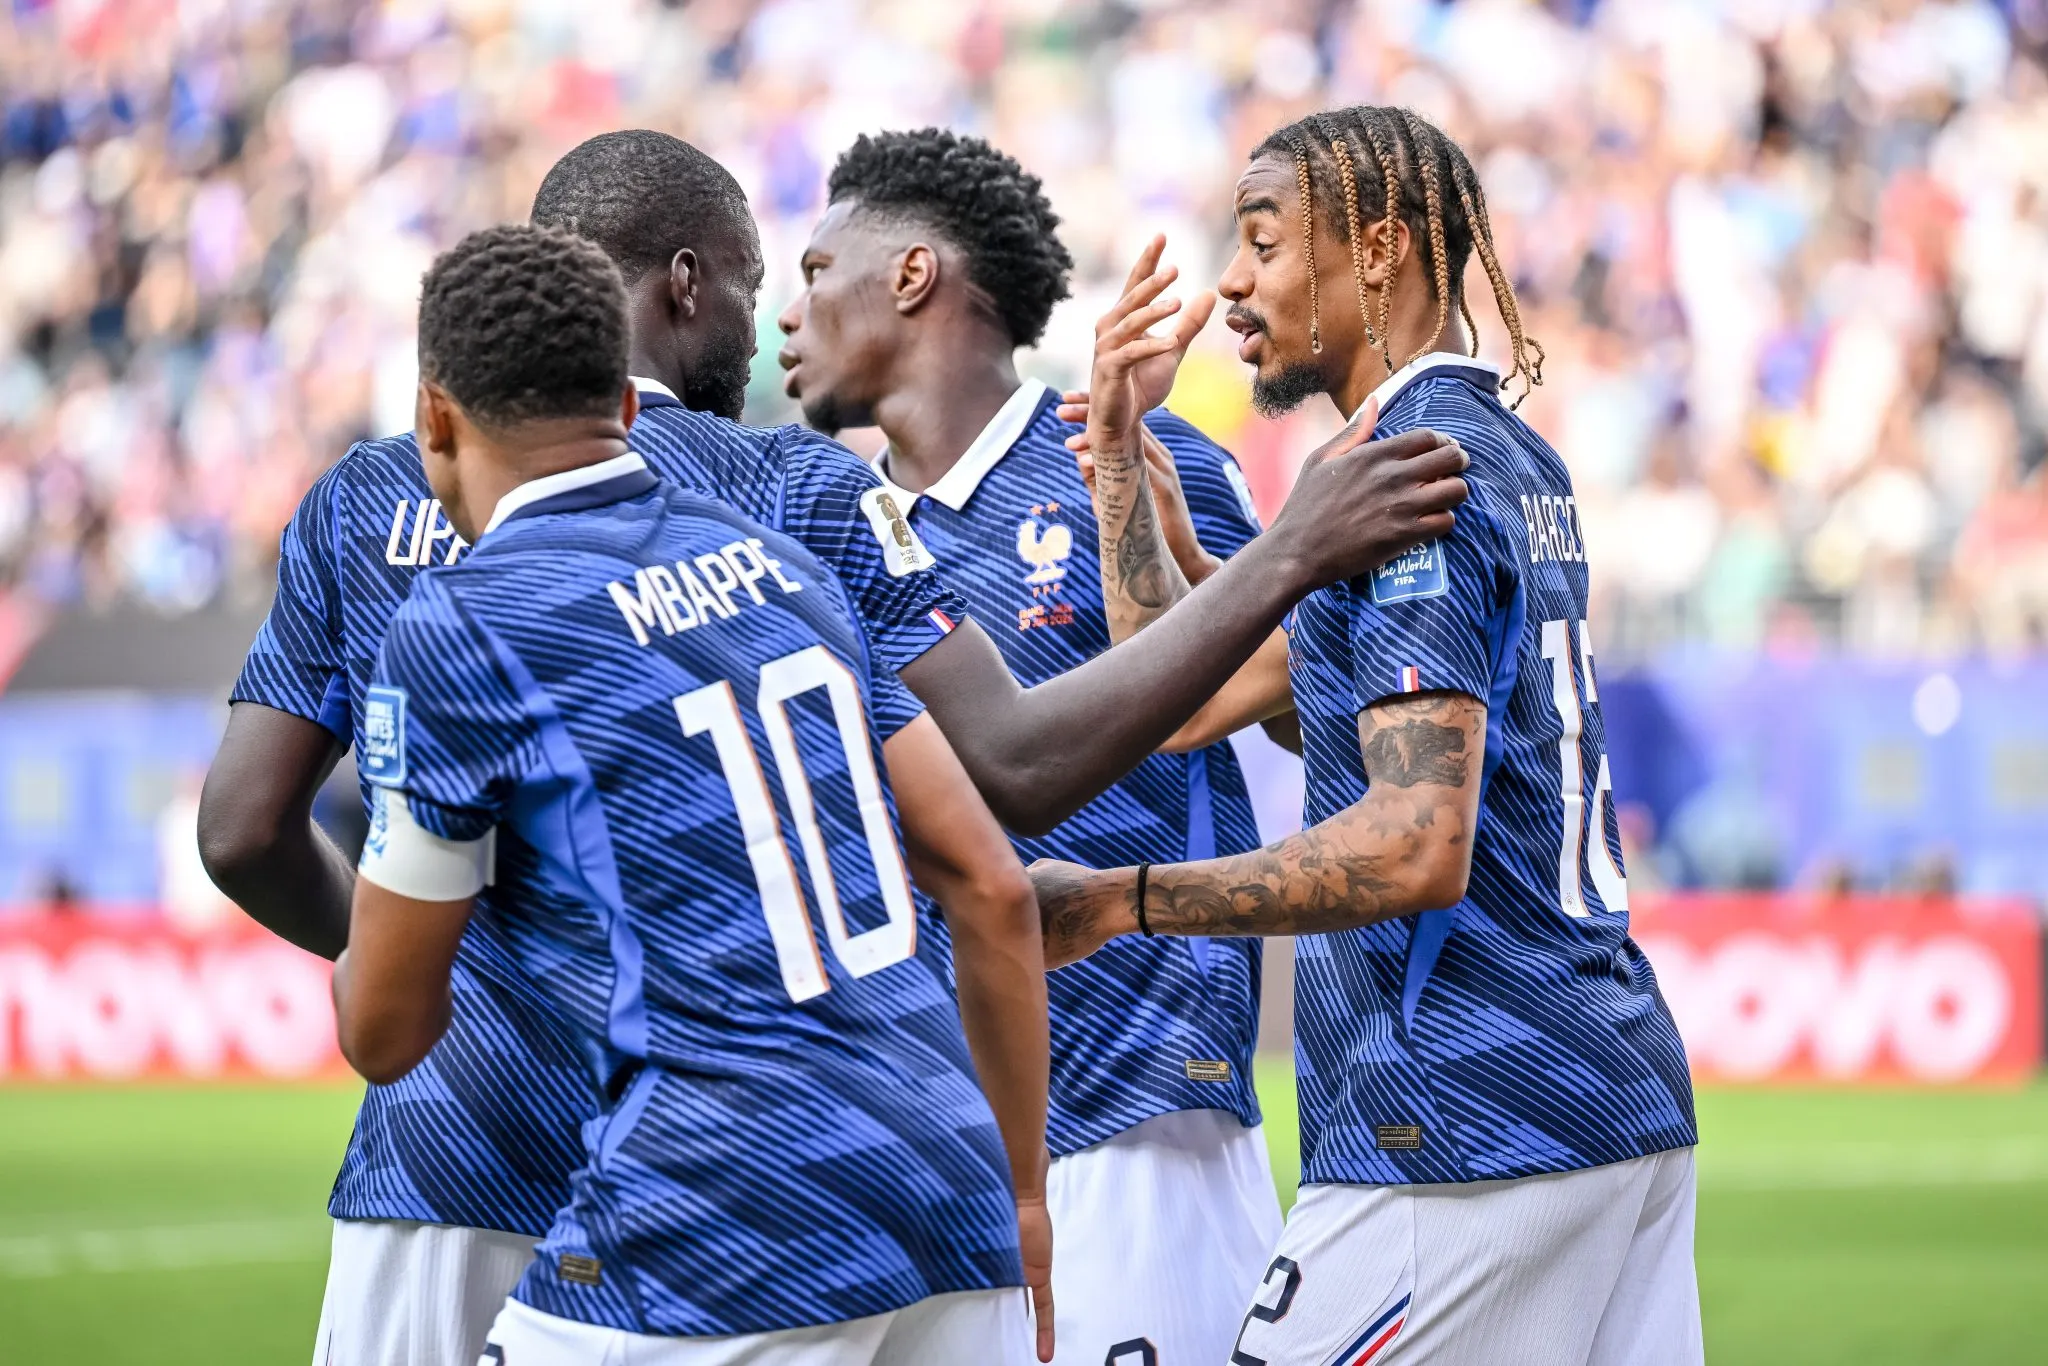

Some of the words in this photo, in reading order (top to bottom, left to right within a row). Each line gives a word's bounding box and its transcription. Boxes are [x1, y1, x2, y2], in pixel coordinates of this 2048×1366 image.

[606, 537, 802, 647] MBAPPE
[1376, 562, 1396, 580] the
[1397, 554, 1433, 575] World
[1394, 575, 1417, 587] FIFA
[672, 644, 917, 1004] 10
